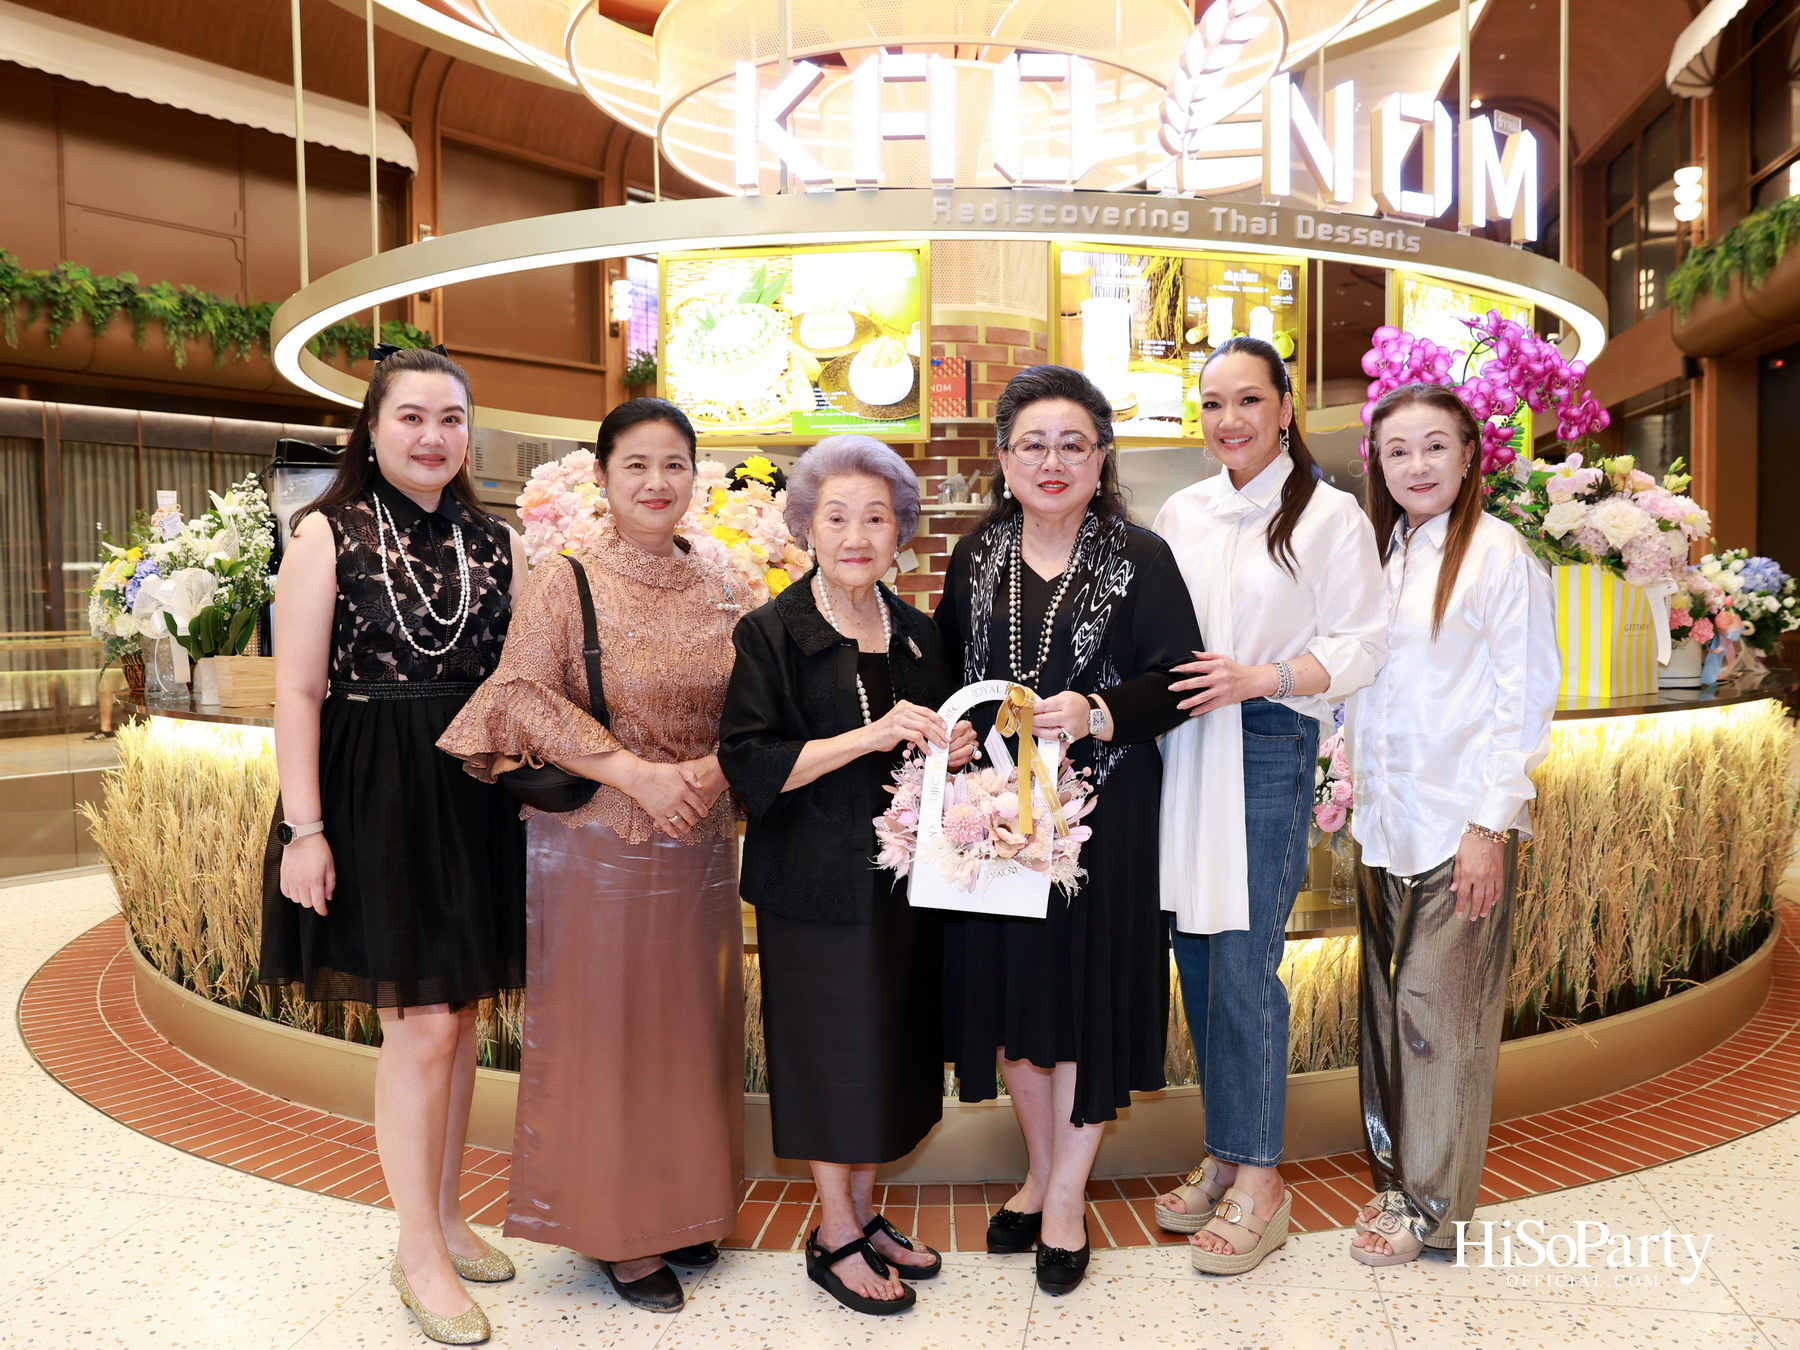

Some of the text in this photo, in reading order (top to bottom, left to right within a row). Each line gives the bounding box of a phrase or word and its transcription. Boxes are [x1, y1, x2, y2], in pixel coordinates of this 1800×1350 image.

[1263, 72, 1538, 243] NOM
[932, 196, 1421, 254] Rediscovering Thai Desserts
[930, 384, 952, 393] NOM
